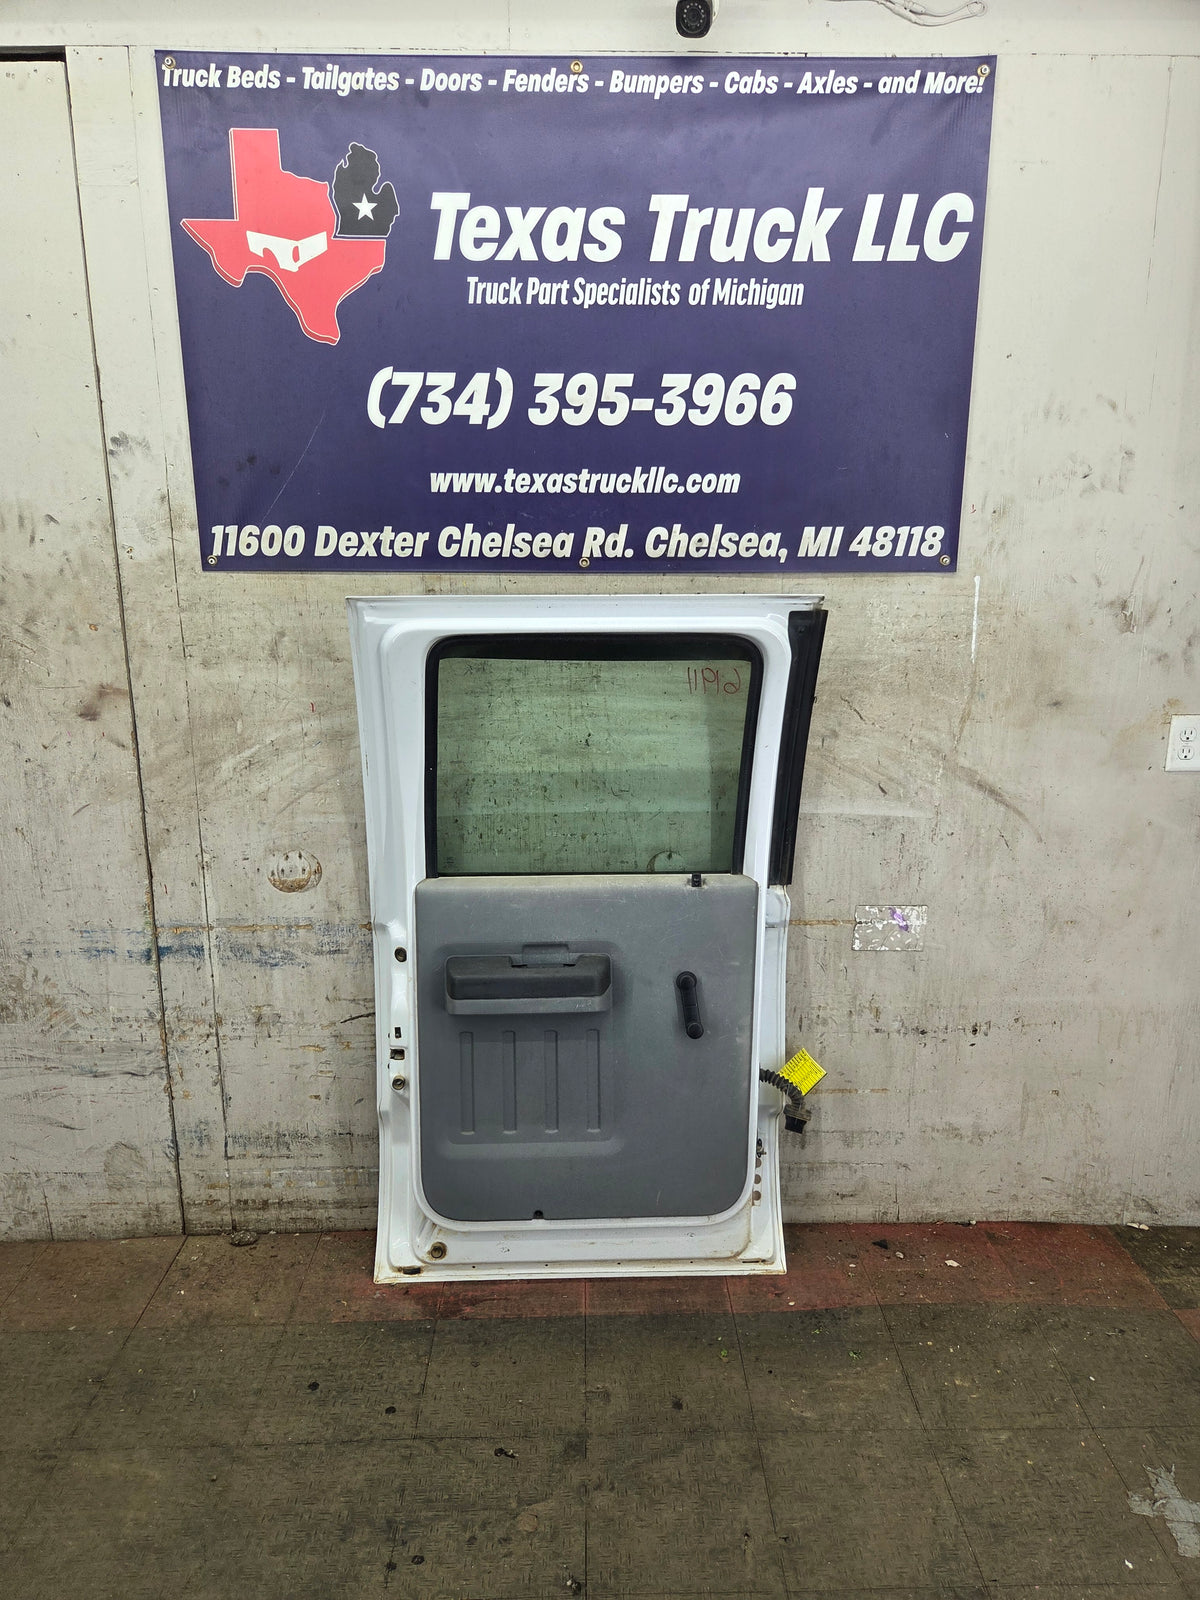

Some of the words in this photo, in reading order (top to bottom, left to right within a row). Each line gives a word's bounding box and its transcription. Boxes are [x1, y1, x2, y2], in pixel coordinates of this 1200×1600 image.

[161, 64, 222, 88] Truck
[227, 65, 281, 89] Beds
[302, 66, 400, 96] Tailgates
[420, 68, 483, 92] Doors
[503, 69, 590, 93] Fenders
[609, 70, 704, 99] Bumpers
[724, 69, 779, 94] Cabs
[797, 70, 858, 94] Axles
[878, 69, 921, 94] and
[922, 73, 986, 94] More!
[430, 192, 626, 262] Texas
[648, 187, 844, 262] Truck
[852, 192, 976, 262] LLC
[467, 277, 523, 305] Truck
[526, 277, 570, 306] Part
[573, 277, 681, 309] Specialists
[688, 278, 711, 306] of
[712, 278, 804, 309] Michigan
[367, 366, 514, 429] (734)
[527, 372, 797, 426] 395-3966
[430, 467, 741, 494] www.texastruckllc.com
[210, 525, 306, 557] 11600
[315, 526, 429, 558] Dexter
[437, 523, 574, 558] Chelsea
[582, 524, 634, 558] Rd.
[645, 524, 788, 563] Chelsea,
[797, 526, 845, 557] MI
[848, 525, 945, 557] 48118
